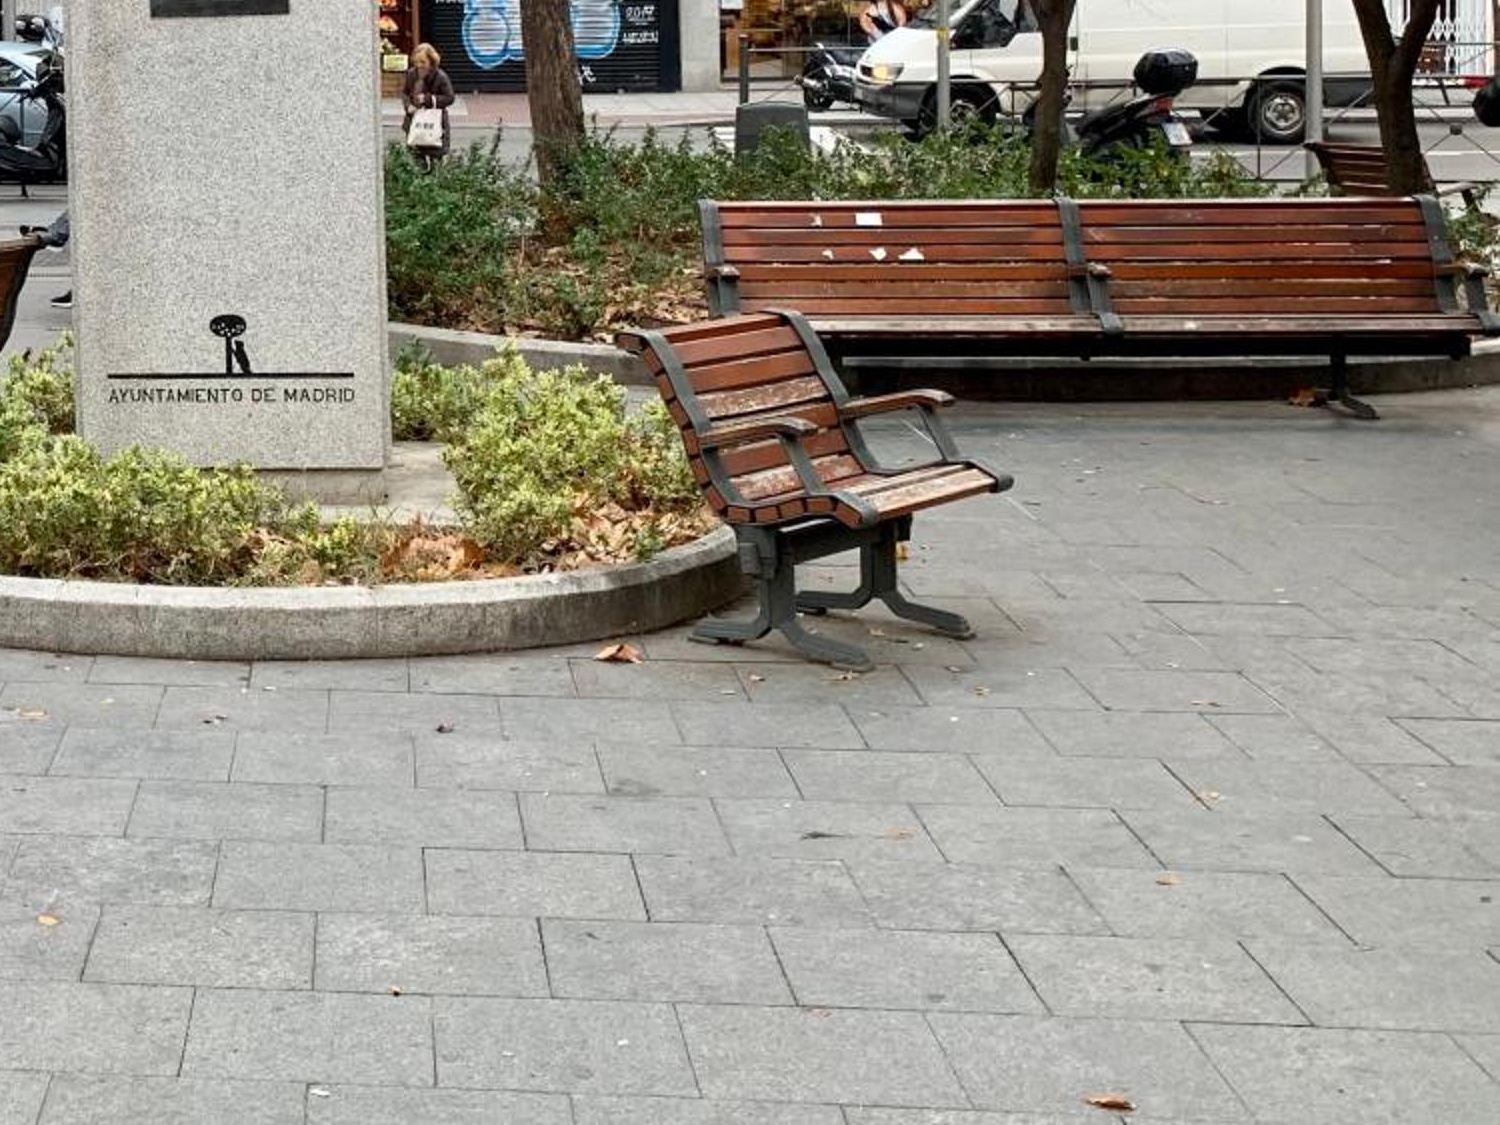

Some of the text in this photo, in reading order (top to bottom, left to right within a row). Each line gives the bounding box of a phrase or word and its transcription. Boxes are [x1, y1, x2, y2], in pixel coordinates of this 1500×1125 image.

[108, 387, 356, 404] AYUNTAMIENTO DE MADRID
